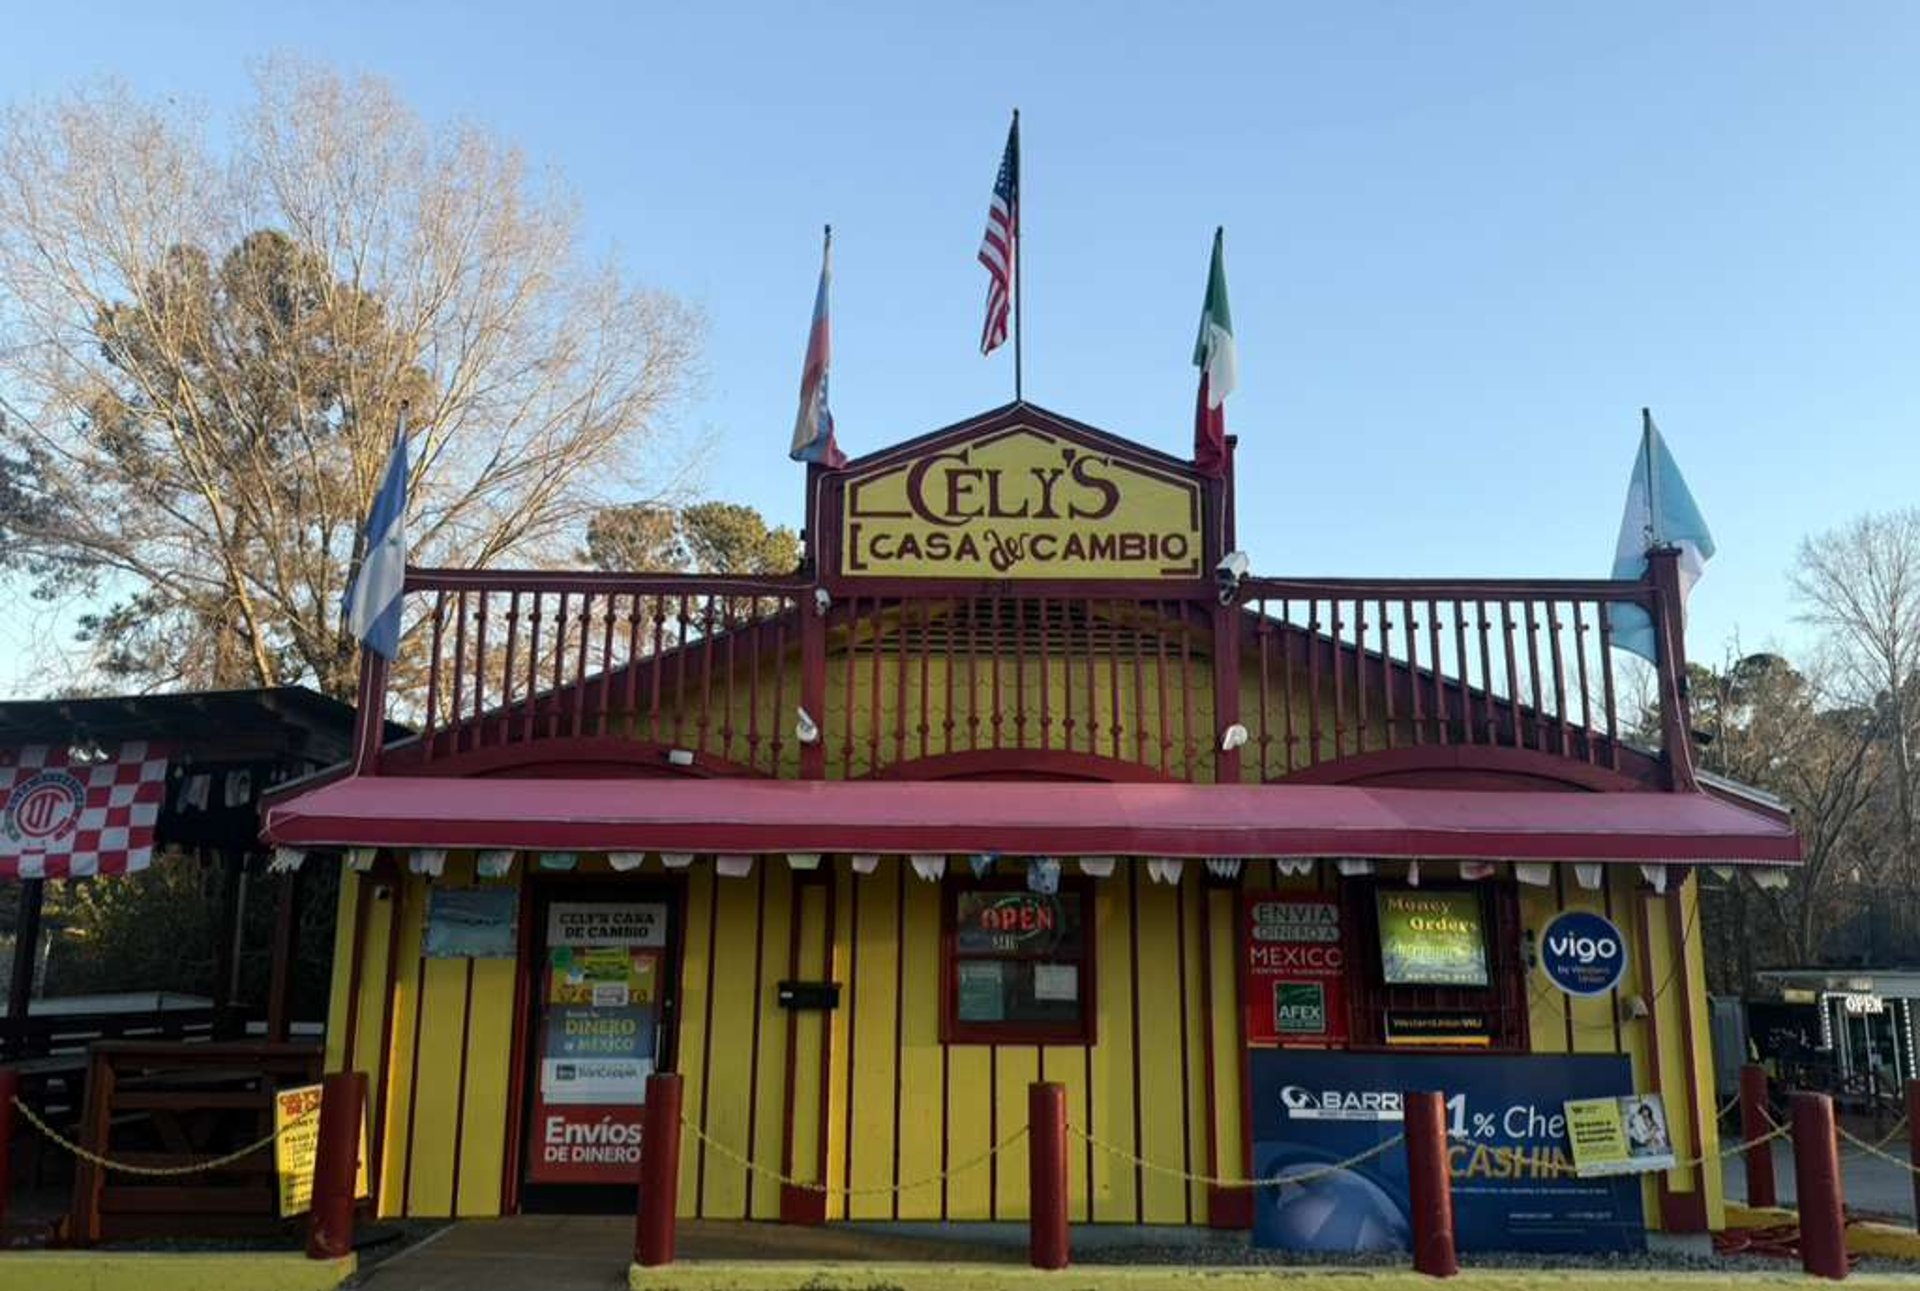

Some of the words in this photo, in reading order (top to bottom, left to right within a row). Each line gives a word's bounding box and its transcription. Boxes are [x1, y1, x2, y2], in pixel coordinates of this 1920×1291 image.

[906, 449, 1120, 527] CELY'S
[869, 533, 979, 561] CASA
[983, 529, 1030, 571] de
[1030, 533, 1188, 562] CAMBIO
[1259, 905, 1332, 921] ENVIA
[1387, 896, 1452, 914] Money
[981, 906, 1054, 930] OPEN
[1409, 915, 1477, 932] Orders
[564, 926, 584, 938] DE
[1548, 930, 1618, 963] vigo
[1250, 946, 1344, 967] MEXICO
[1278, 1004, 1321, 1020] AFEX
[1846, 993, 1884, 1013] OPEN
[565, 1018, 637, 1035] DINERO
[545, 1114, 643, 1145] Envíos
[544, 1145, 569, 1163] DE
[571, 1145, 642, 1163] DINERO
